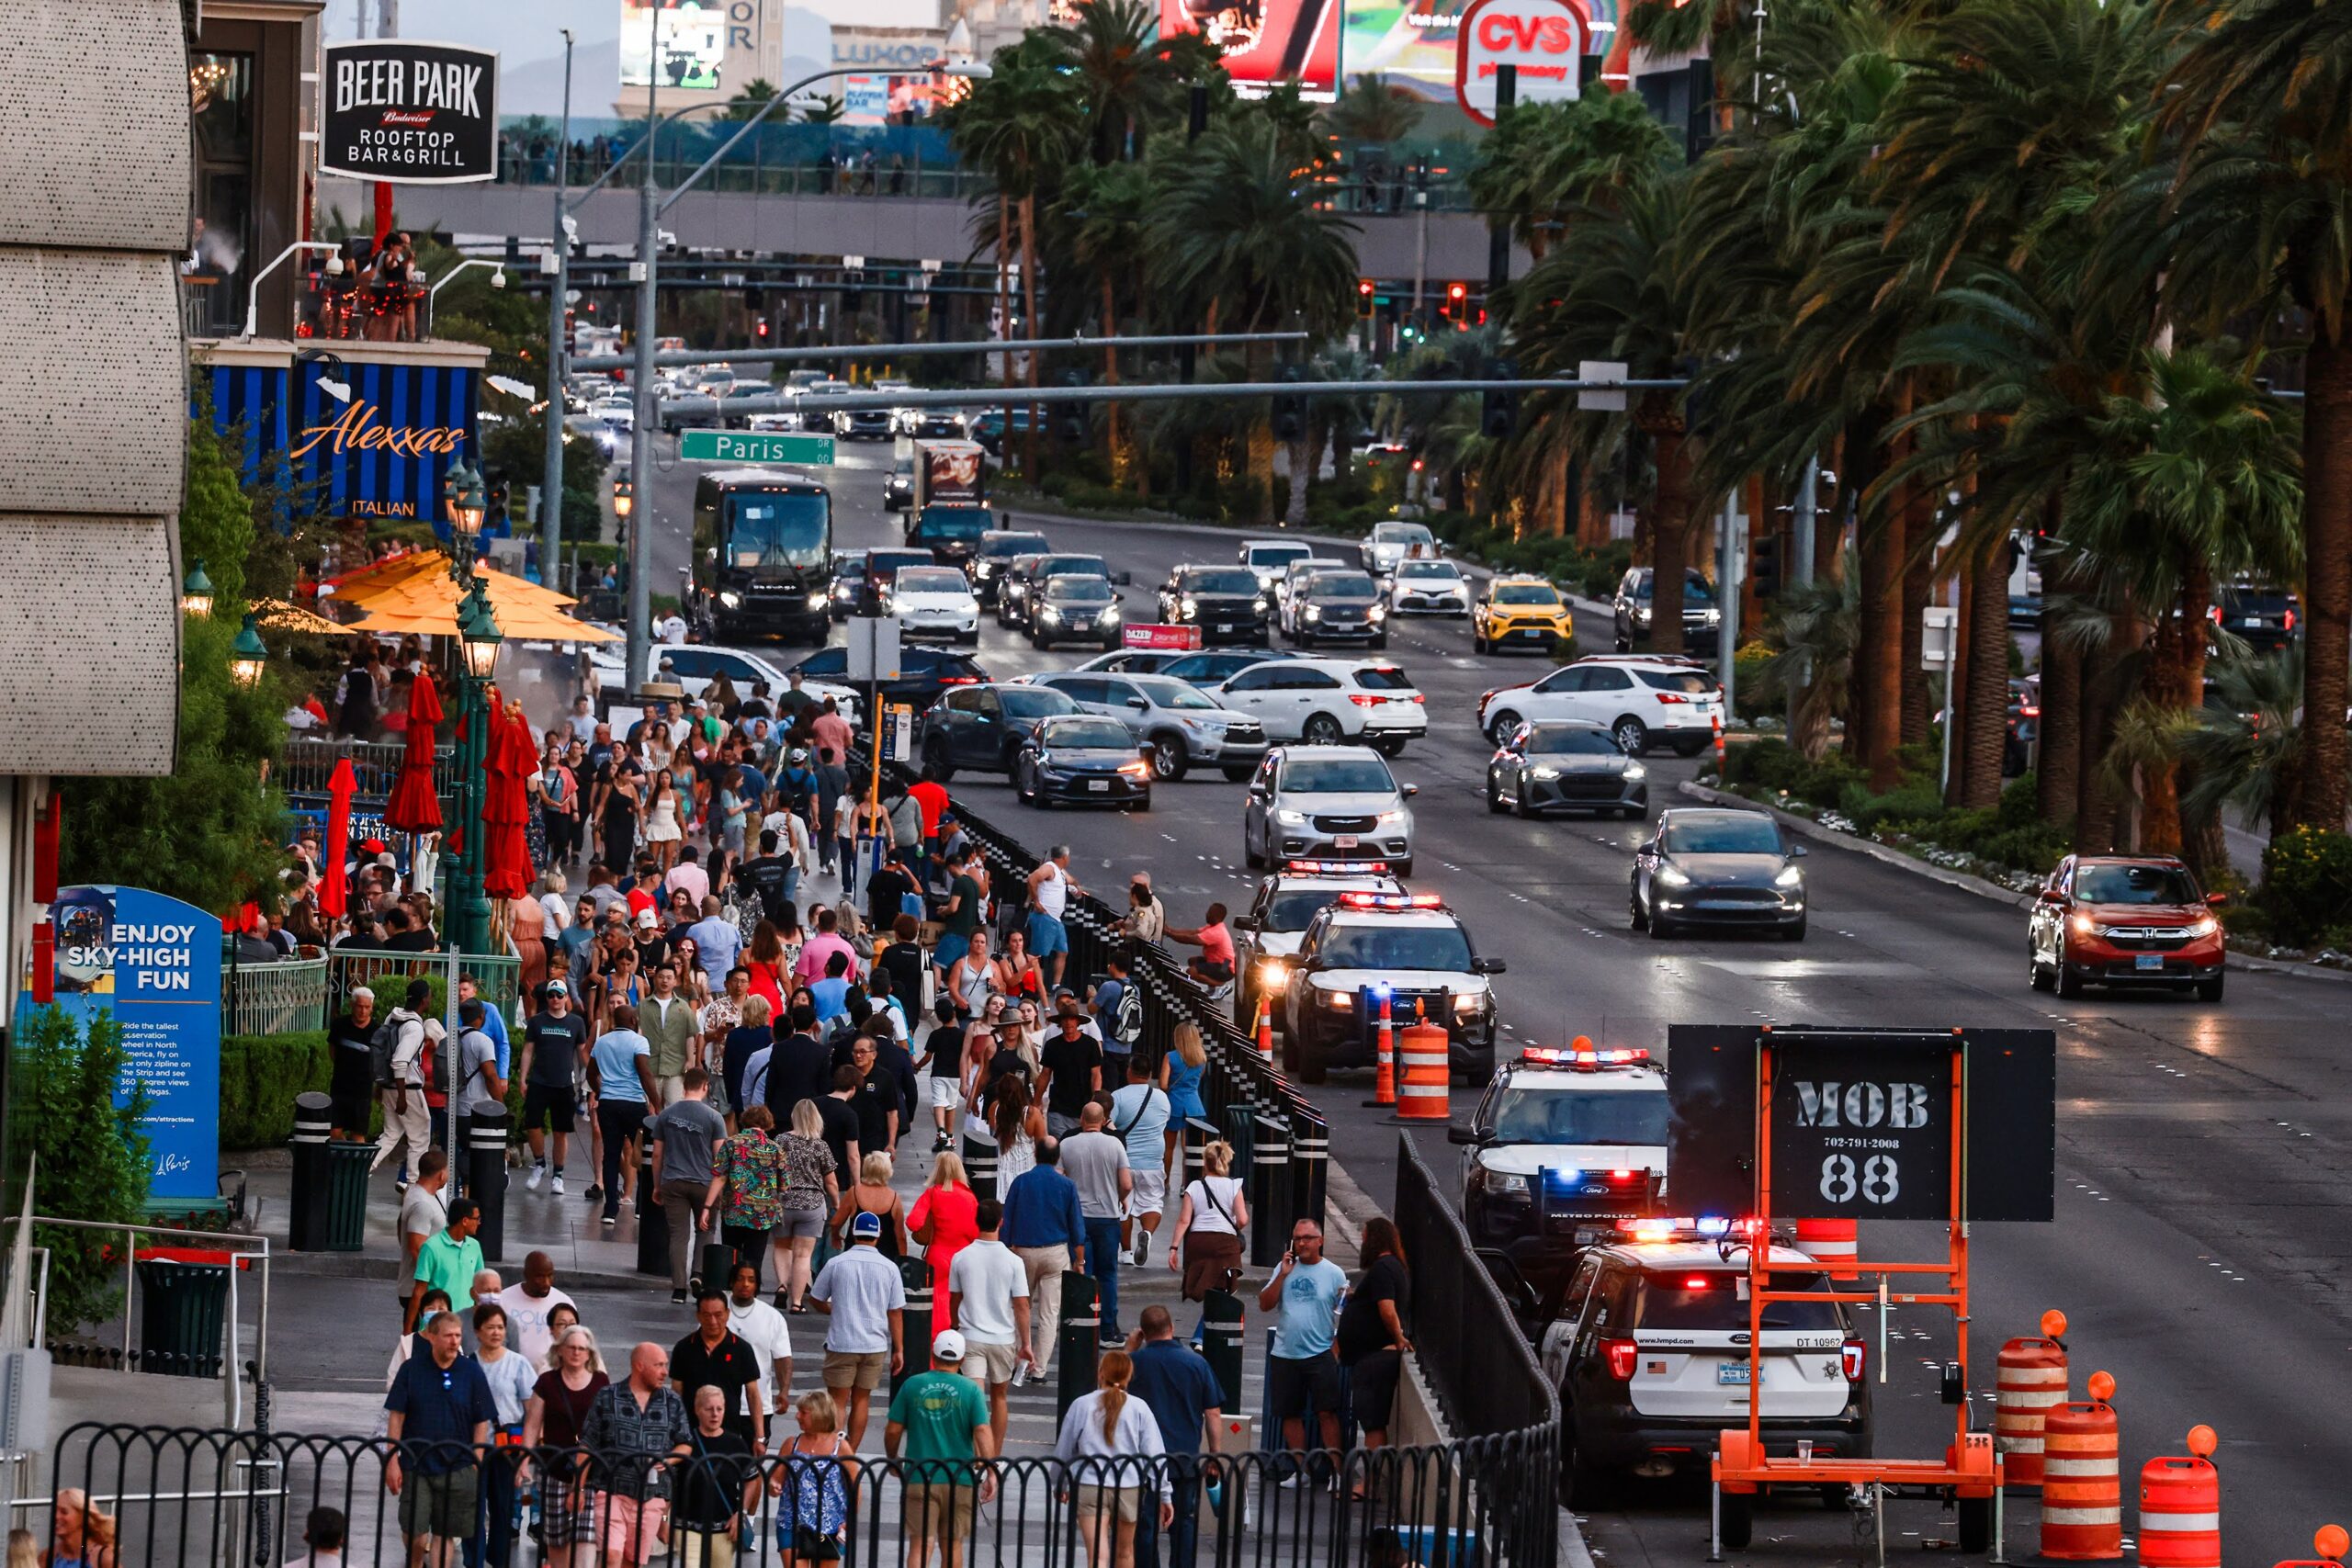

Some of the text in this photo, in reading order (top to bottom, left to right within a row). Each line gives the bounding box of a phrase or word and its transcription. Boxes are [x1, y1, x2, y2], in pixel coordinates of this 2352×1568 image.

[1476, 14, 1572, 54] CVS
[335, 60, 482, 118] BEER PARK
[382, 110, 431, 123] Budweiser
[360, 129, 455, 148] ROOFTOP
[348, 146, 465, 166] BAR&GRILL
[717, 436, 785, 459] Paris
[818, 439, 830, 448] DR
[353, 500, 415, 516] ITALIAN
[111, 924, 196, 944] ENJOY
[68, 946, 190, 967] SKY-HIGH
[138, 971, 190, 990] FUN
[121, 1021, 140, 1030] Ride
[123, 1050, 155, 1058] merica,
[157, 1050, 167, 1059] fly
[136, 1060, 153, 1068] only
[154, 1060, 179, 1068] zipline
[136, 1069, 154, 1077] Strip
[120, 1077, 136, 1086] 360
[146, 1088, 172, 1097] Vegas.
[1793, 1081, 1928, 1129] MOB
[1824, 1137, 1900, 1149] 702-791-2008
[1819, 1154, 1900, 1204] 88
[1796, 1337, 1841, 1347] DT 10962
[1739, 1368, 1764, 1379] 057
